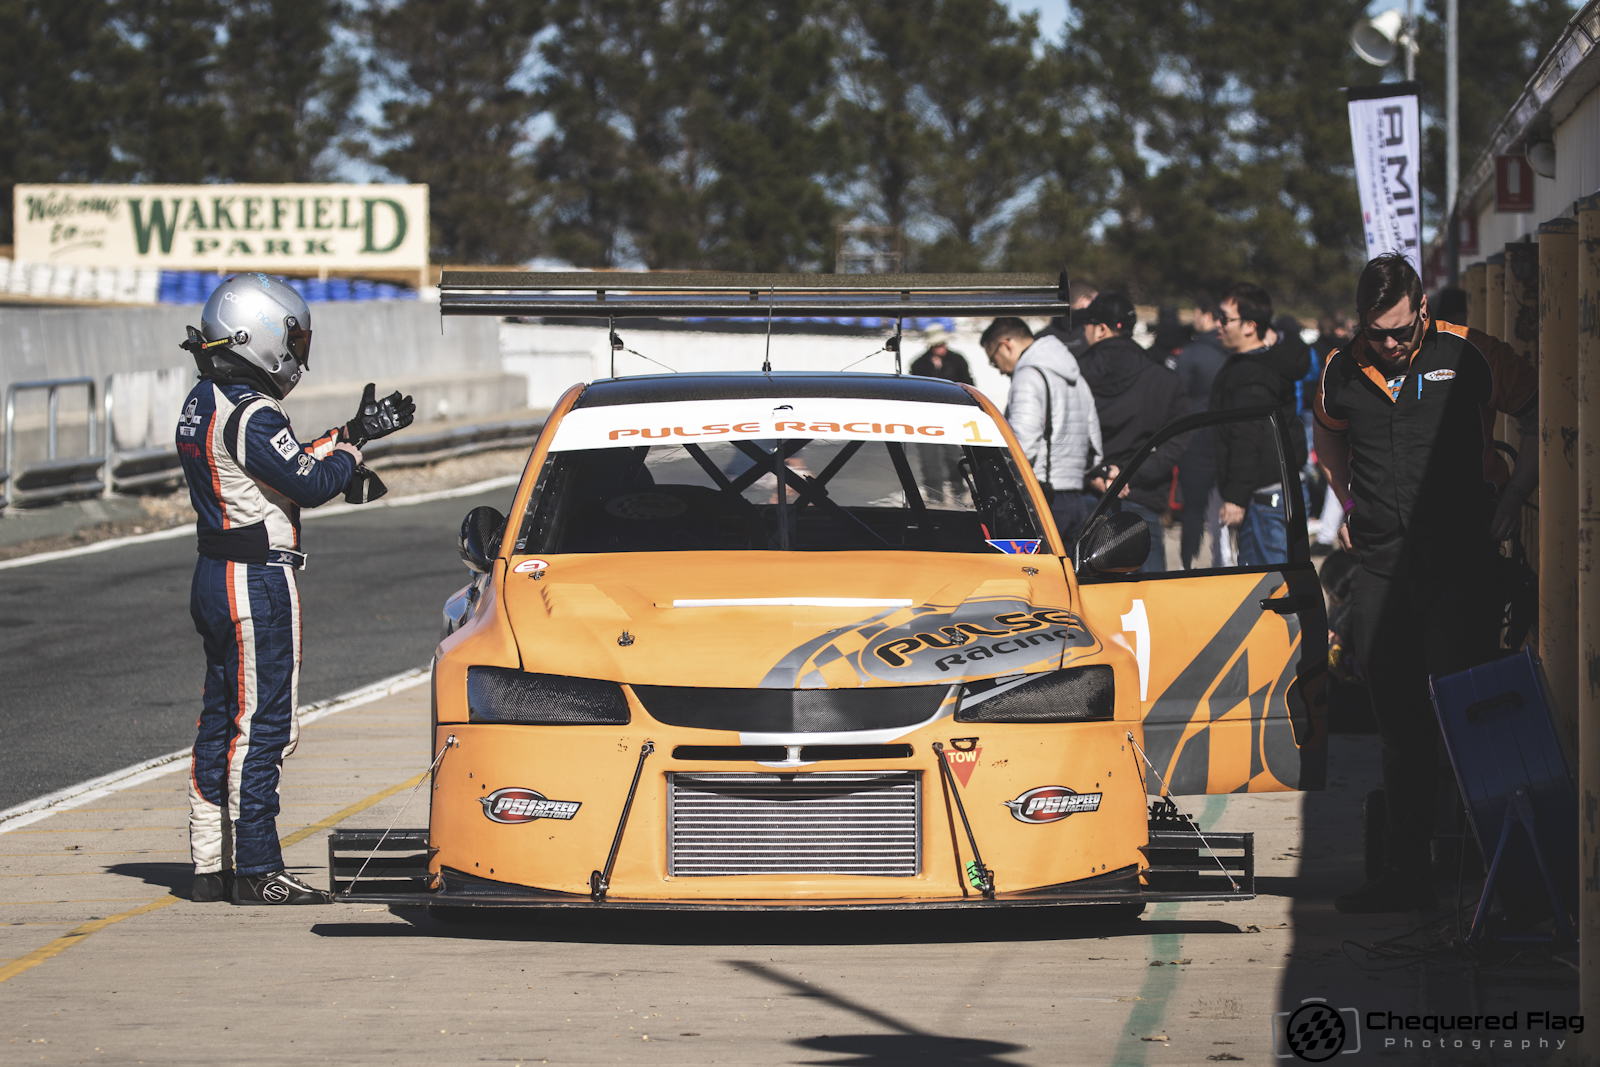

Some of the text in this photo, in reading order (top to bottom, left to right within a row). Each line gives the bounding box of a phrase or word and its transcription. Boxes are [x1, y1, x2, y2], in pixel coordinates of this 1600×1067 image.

[25, 190, 120, 221] Welcome
[128, 196, 408, 256] WAKEFIELD
[192, 237, 337, 256] PARK
[255, 308, 283, 338] hope
[608, 422, 761, 441] PULSE
[962, 420, 993, 443] 1
[876, 610, 1079, 667] PULSE
[1120, 598, 1151, 702] 1
[947, 750, 977, 764] TOW
[493, 797, 580, 816] PSI SPEED
[531, 809, 575, 819] FACTORY
[1025, 793, 1101, 815] PSI SPEED
[1065, 803, 1099, 813] FACTORY
